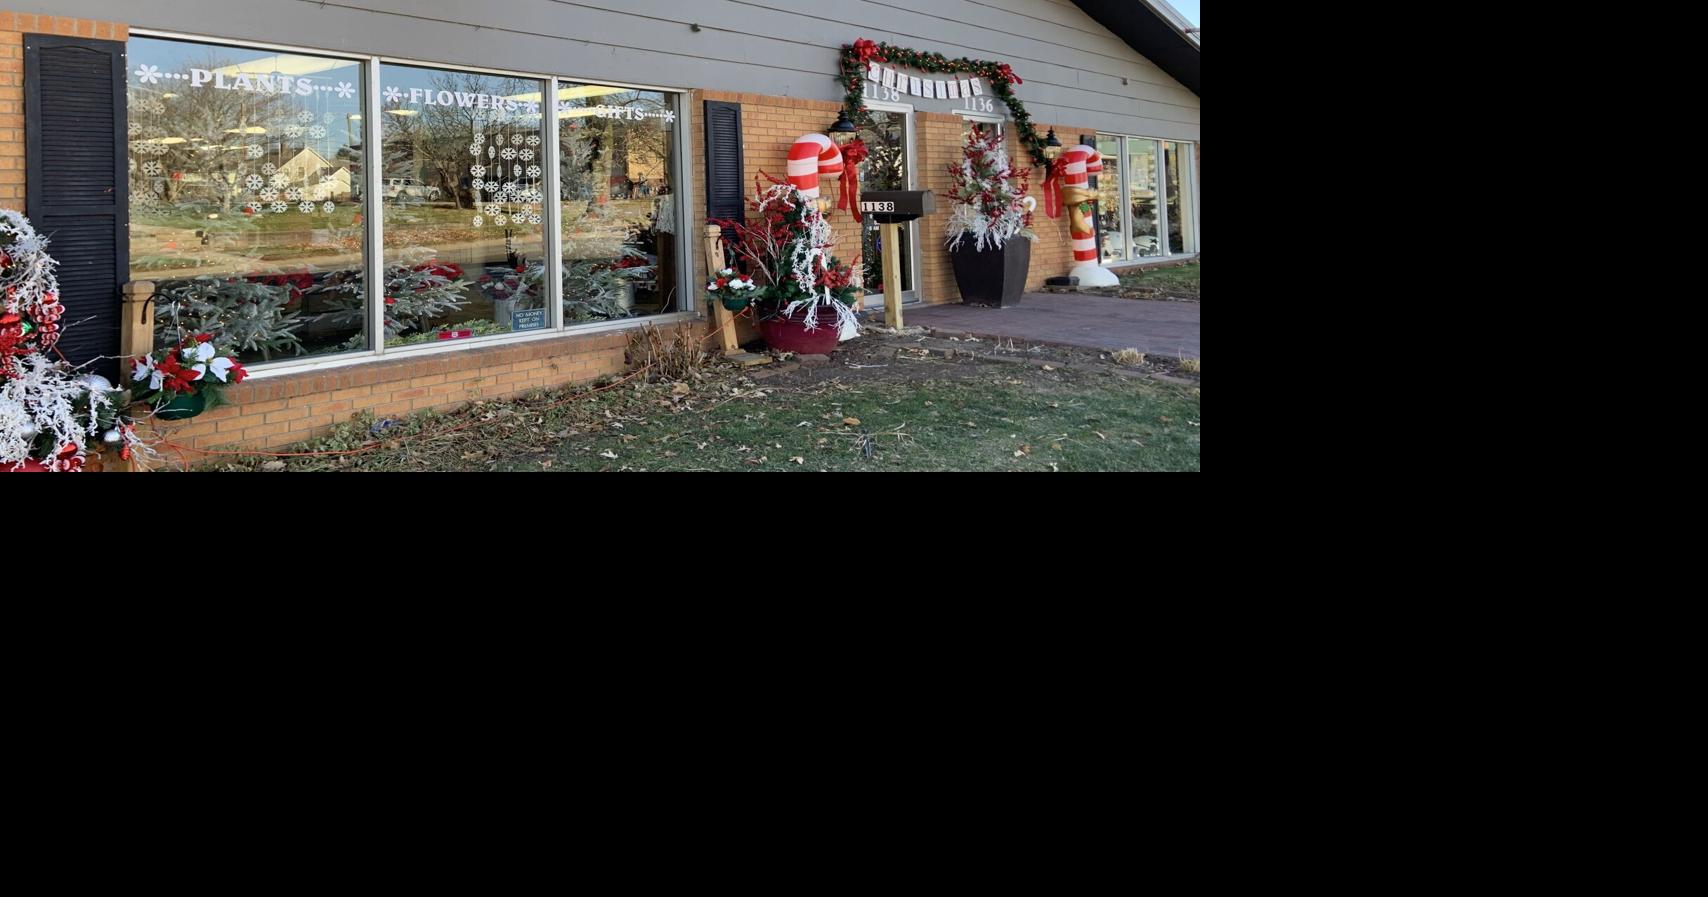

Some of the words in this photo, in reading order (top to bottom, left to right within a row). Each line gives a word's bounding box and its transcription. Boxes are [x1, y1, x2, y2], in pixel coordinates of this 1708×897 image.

[190, 68, 313, 96] PLANTS
[409, 87, 518, 112] FLOWERS
[863, 82, 900, 102] 1138
[594, 104, 645, 121] GIFTS
[964, 97, 993, 113] 1136
[863, 202, 893, 211] 1138
